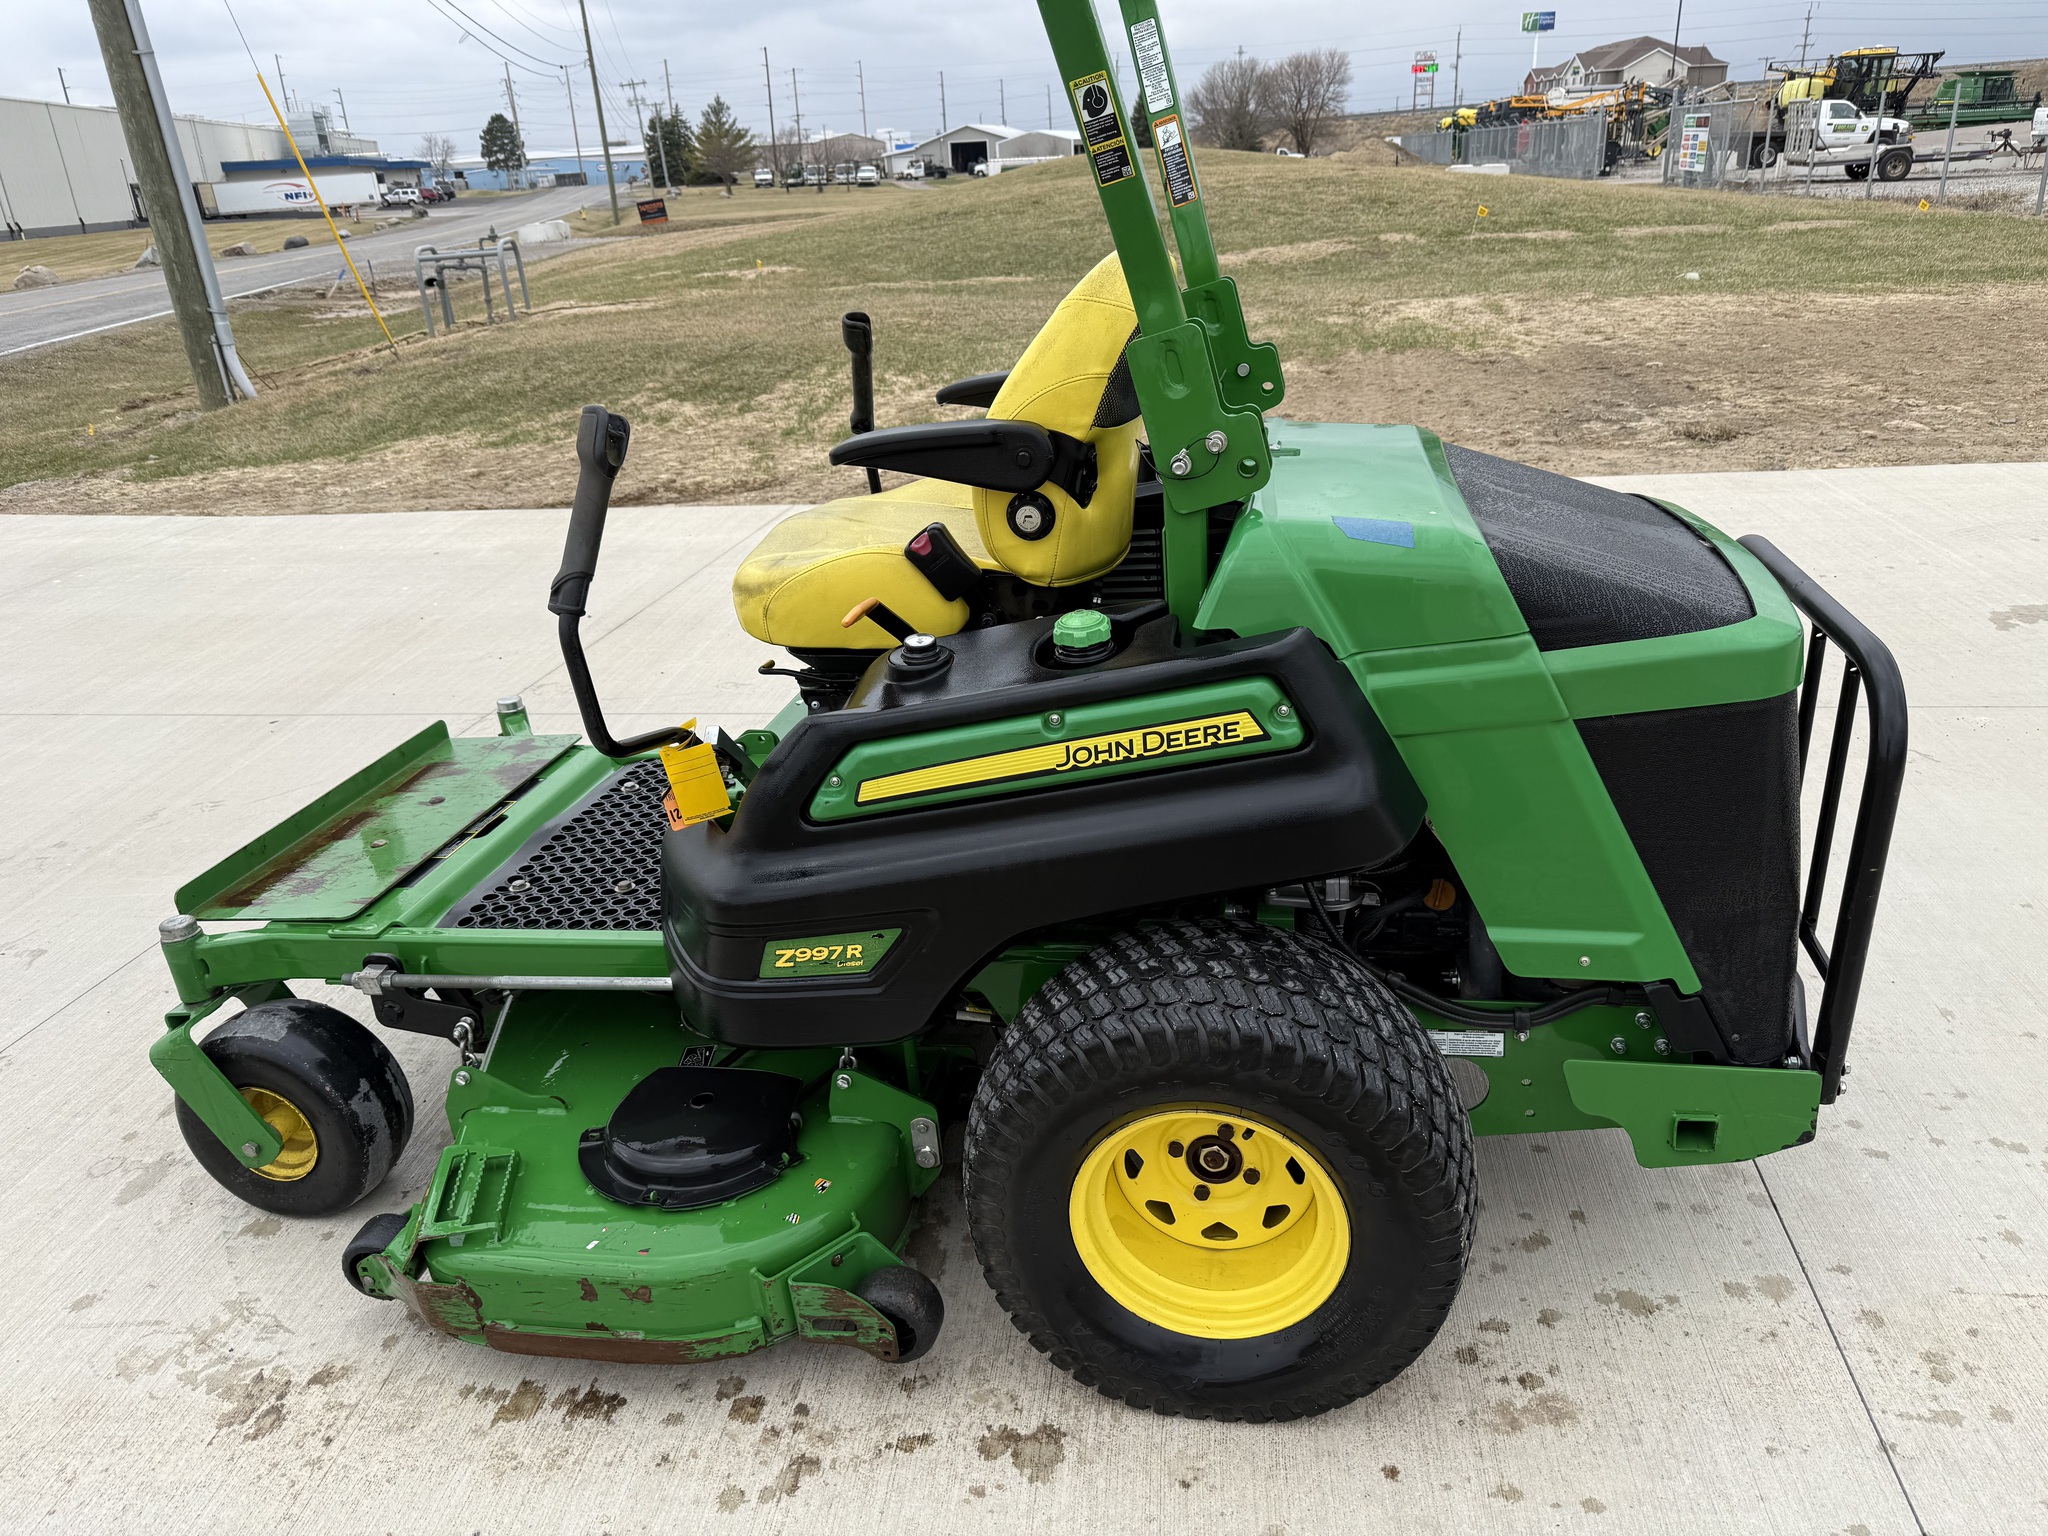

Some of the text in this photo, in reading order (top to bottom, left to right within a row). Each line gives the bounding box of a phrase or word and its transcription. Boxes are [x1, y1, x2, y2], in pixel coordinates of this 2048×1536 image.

[1077, 72, 1104, 86] CAUTION
[1096, 138, 1124, 152] ATENCIÓN
[284, 191, 307, 200] NFI
[1055, 720, 1241, 769] JOHN DEERE
[774, 944, 863, 968] Z997R
